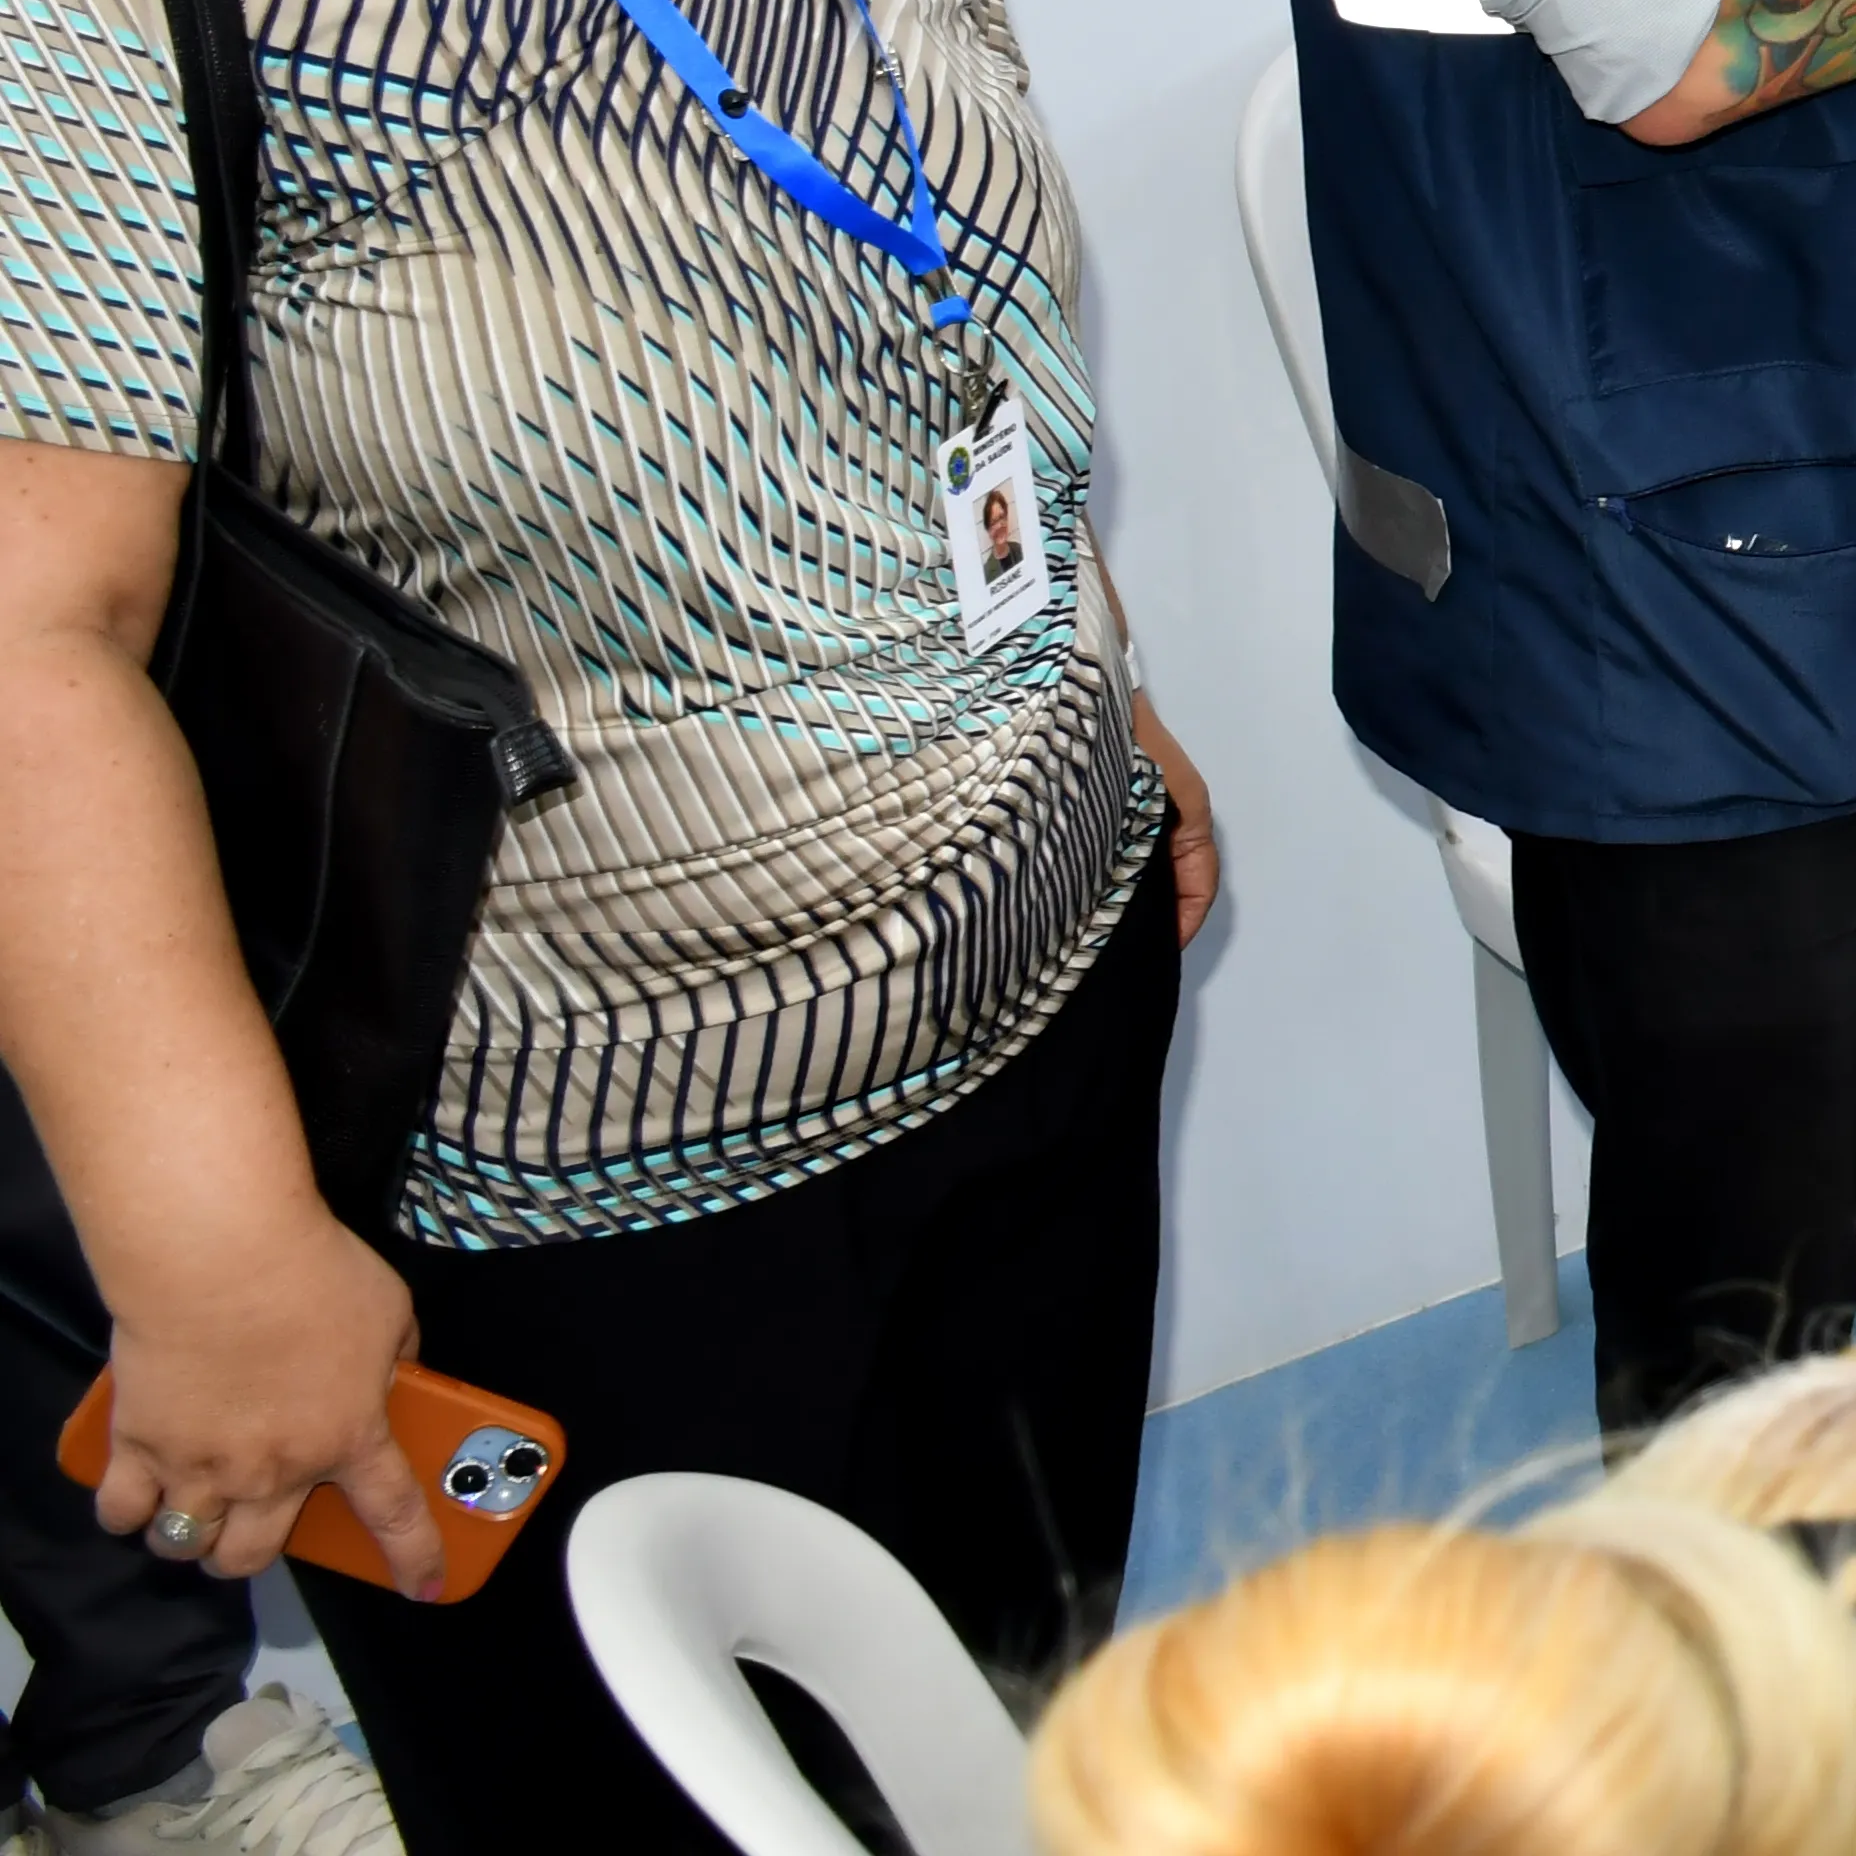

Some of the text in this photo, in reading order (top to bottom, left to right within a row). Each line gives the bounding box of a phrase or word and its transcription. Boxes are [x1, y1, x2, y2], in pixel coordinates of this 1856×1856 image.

[973, 423, 1017, 457] MINISTÉRIO
[975, 441, 1013, 473] DA SAÚDE
[990, 566, 1023, 597] ROSANE
